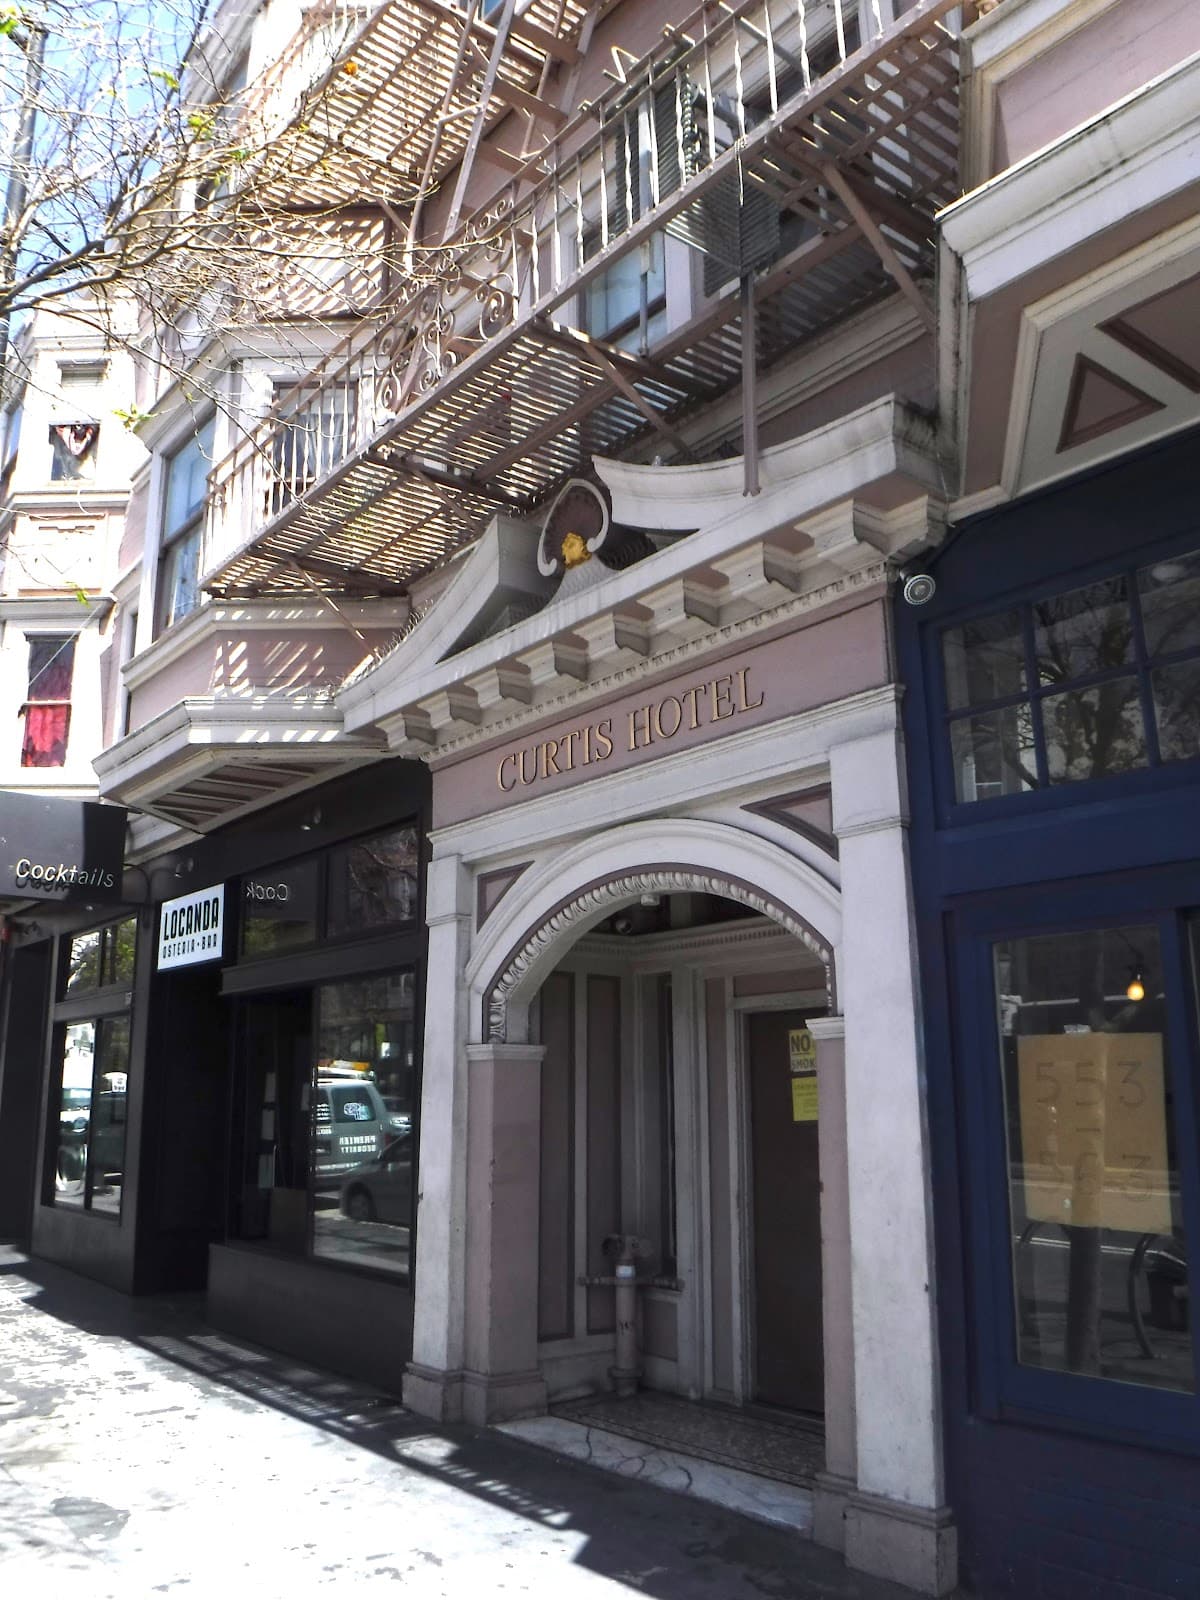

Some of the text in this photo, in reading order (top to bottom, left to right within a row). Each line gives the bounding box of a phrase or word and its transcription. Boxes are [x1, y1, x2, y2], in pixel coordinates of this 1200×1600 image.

[497, 667, 765, 792] CURTIS HOTEL
[16, 858, 114, 888] Cocktails
[163, 897, 219, 941] LOCANDA
[162, 938, 195, 959] OSTERIA
[791, 1034, 810, 1052] NO
[1035, 1061, 1147, 1107] 553
